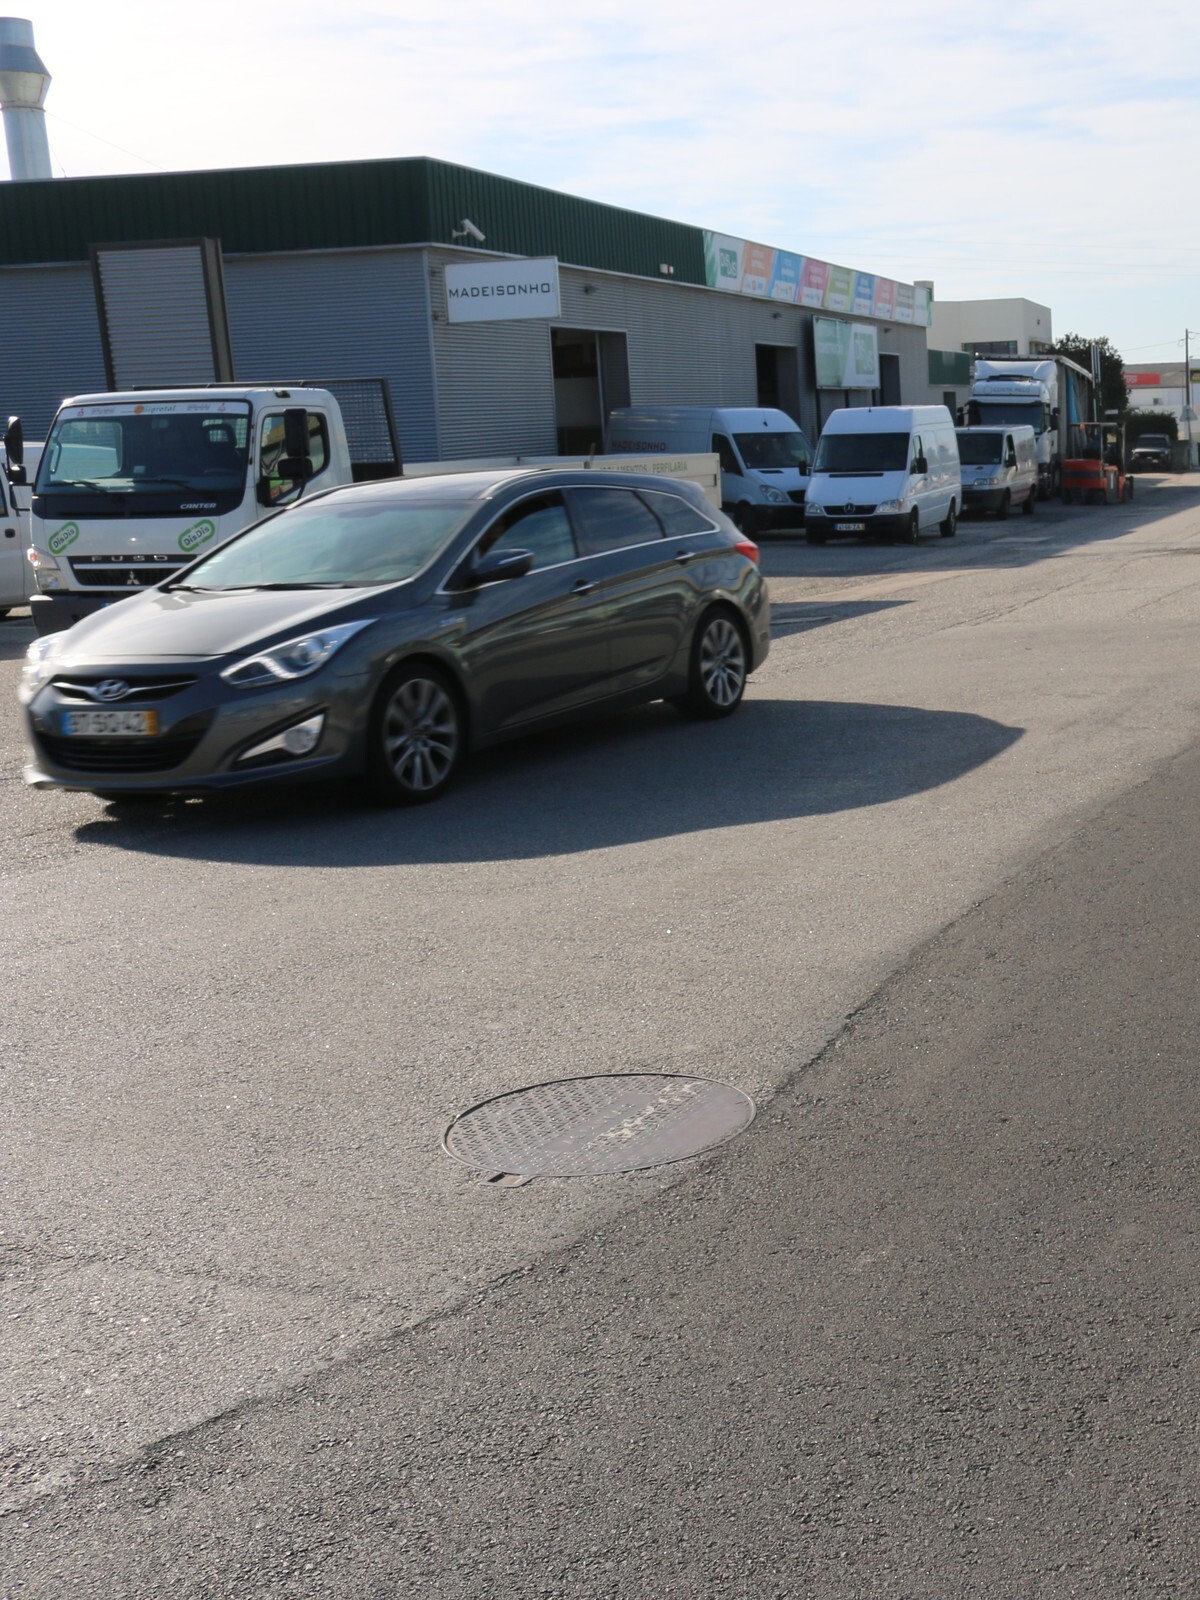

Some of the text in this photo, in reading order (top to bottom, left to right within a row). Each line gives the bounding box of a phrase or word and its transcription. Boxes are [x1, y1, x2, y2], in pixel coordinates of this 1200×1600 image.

[449, 283, 551, 298] MADEISONHO
[53, 528, 76, 549] DisDis
[183, 526, 210, 547] DisDis
